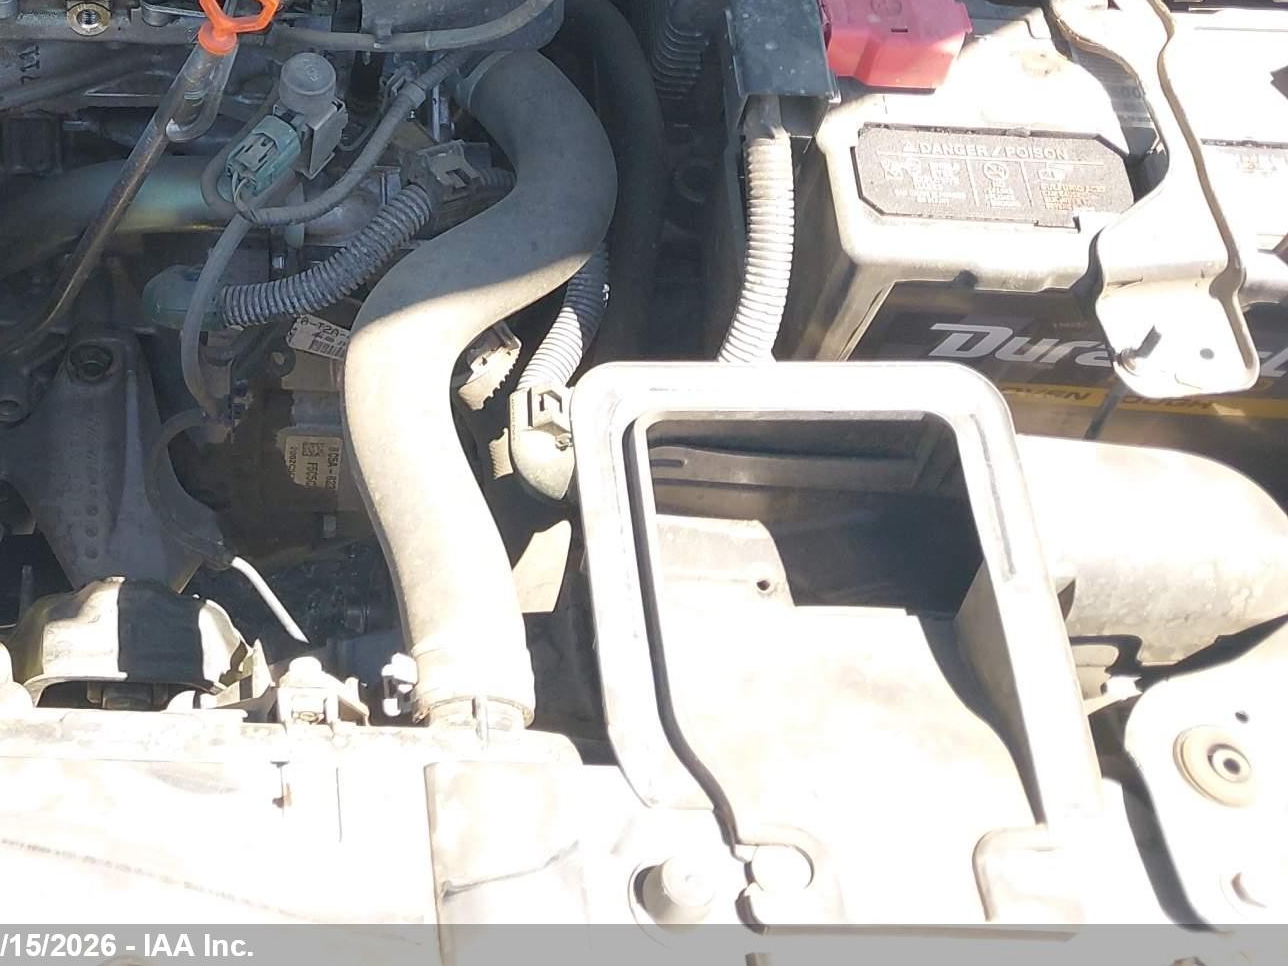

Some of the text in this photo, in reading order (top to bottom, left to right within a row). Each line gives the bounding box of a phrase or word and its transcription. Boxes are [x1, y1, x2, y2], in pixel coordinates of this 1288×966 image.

[919, 143, 989, 158] DANGER
[1003, 146, 1069, 161] POISON
[928, 322, 1113, 368] Dura
